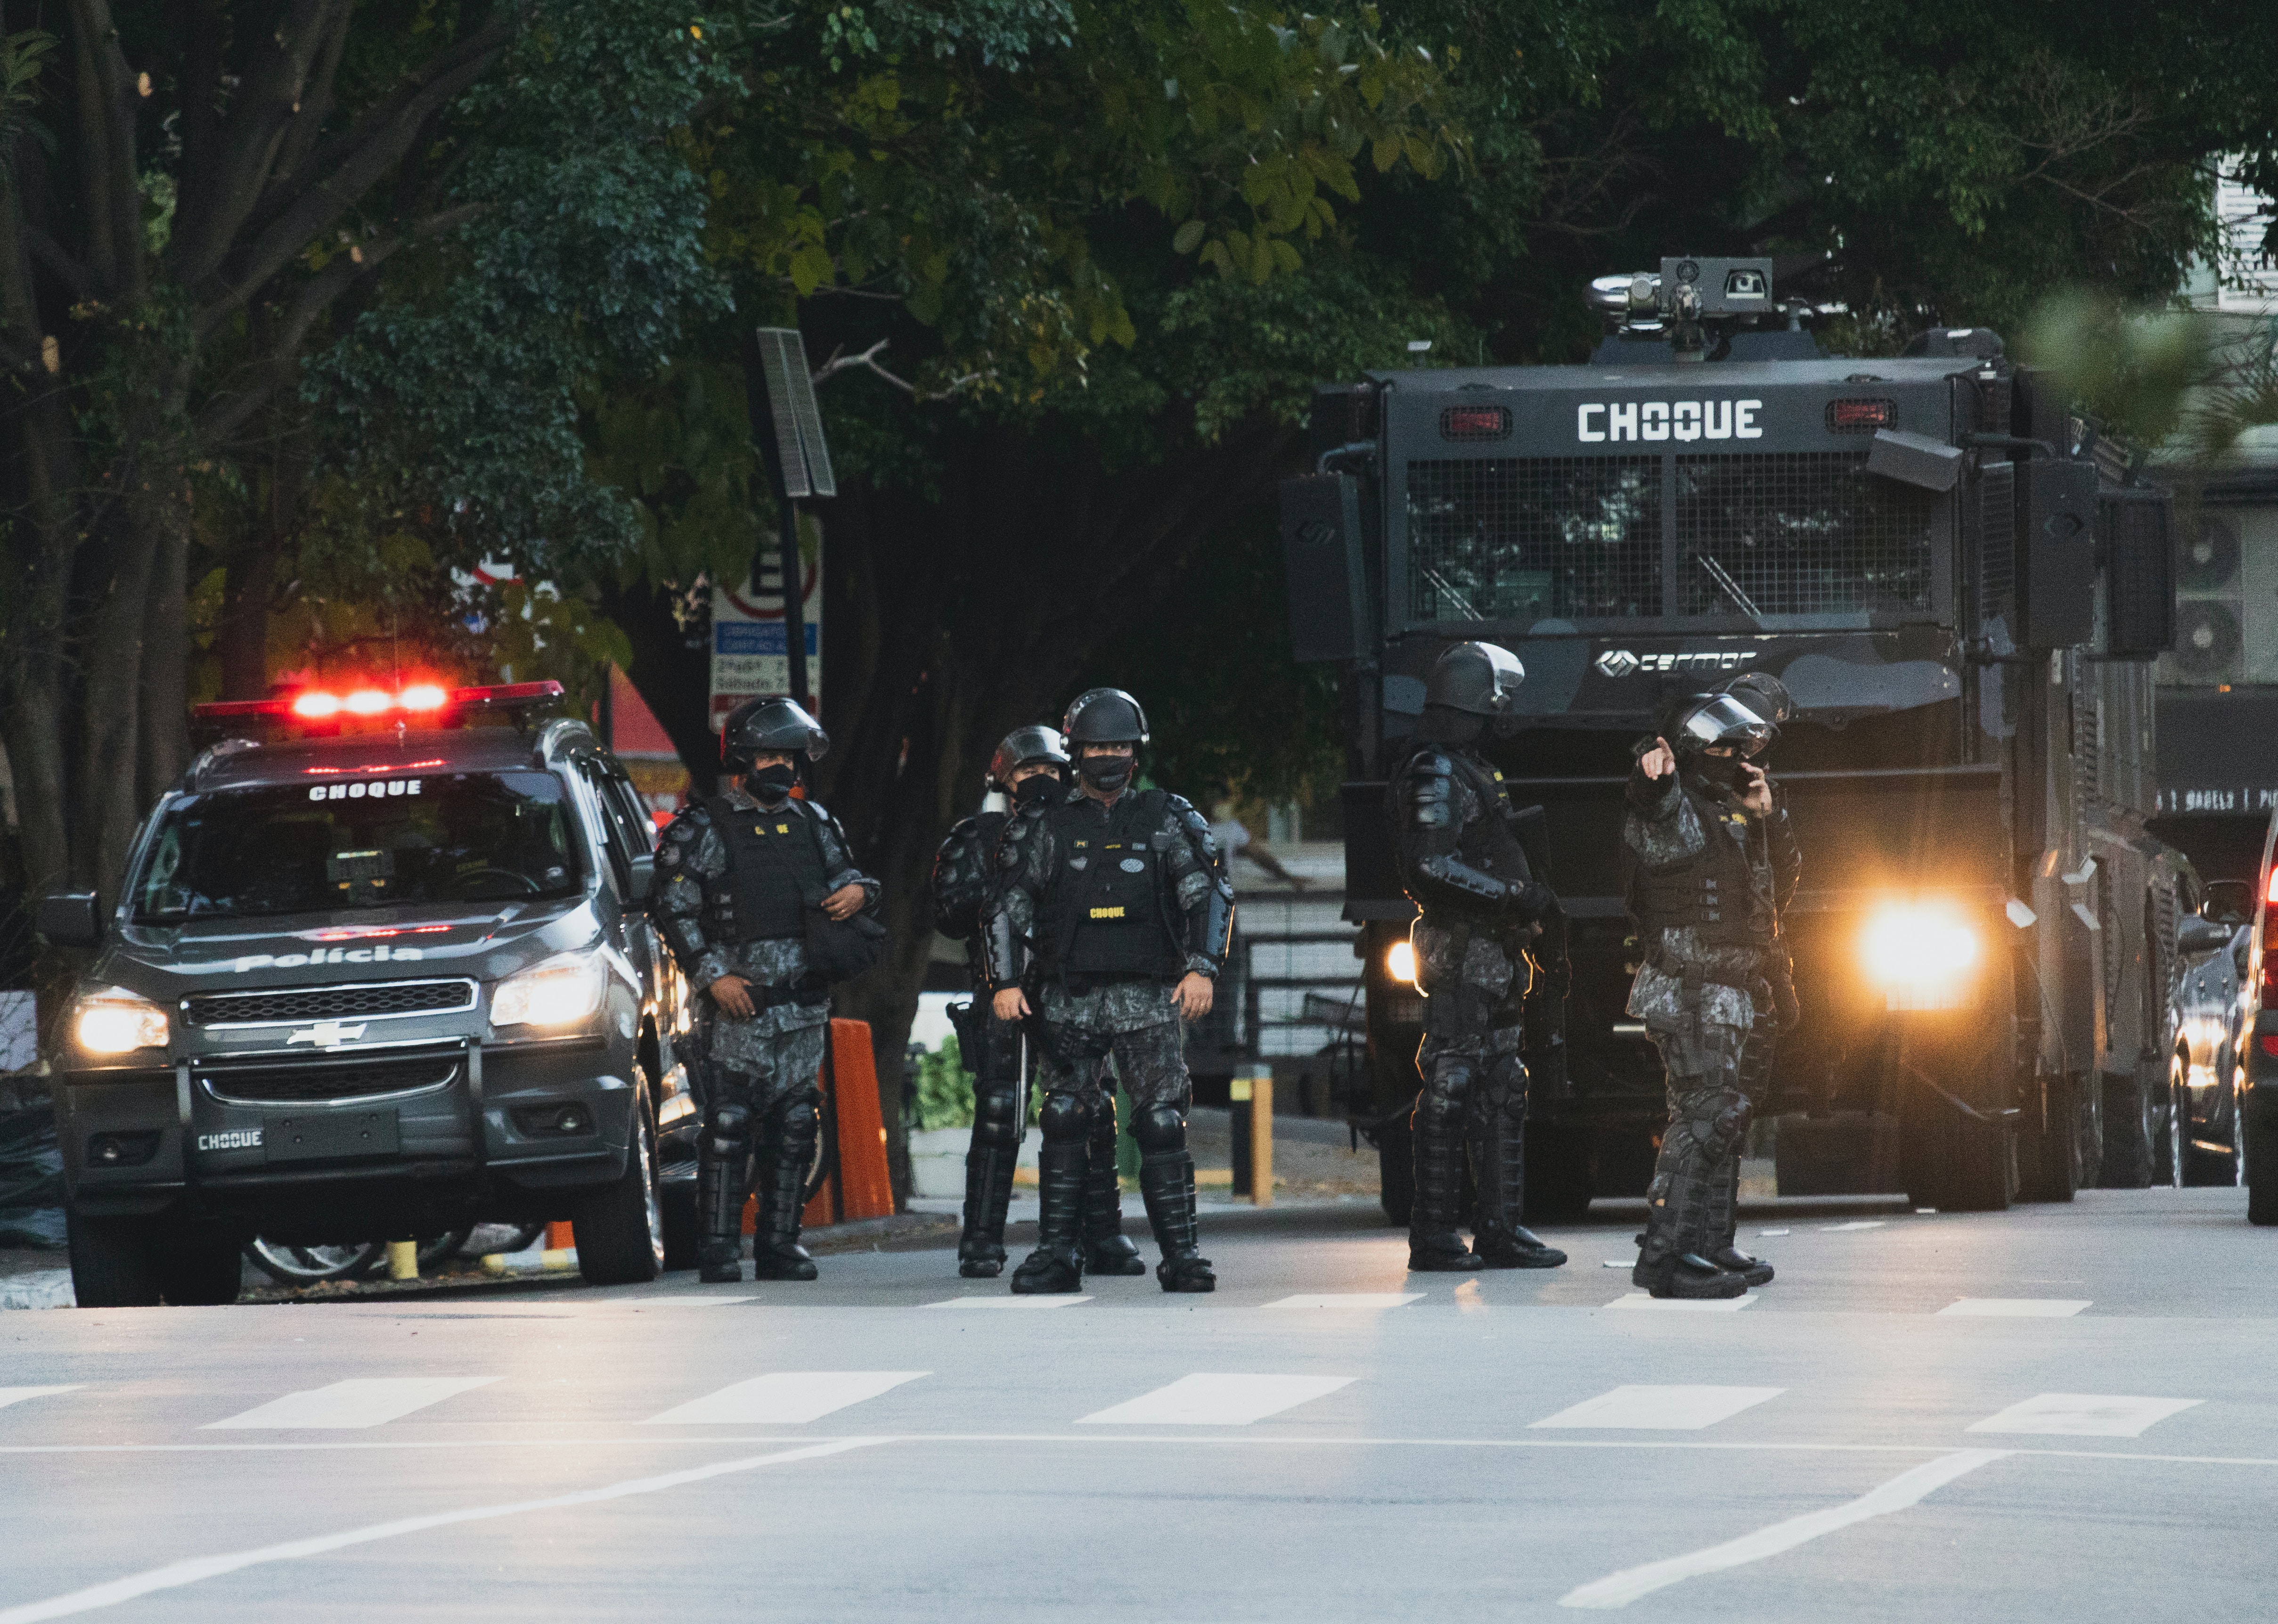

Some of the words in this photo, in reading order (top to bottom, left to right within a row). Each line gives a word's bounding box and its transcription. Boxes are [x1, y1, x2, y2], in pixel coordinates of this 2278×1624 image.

[1578, 400, 1762, 442] CHOQUE
[309, 780, 421, 801] CHOQUE
[1090, 906, 1125, 919] CHOQUE
